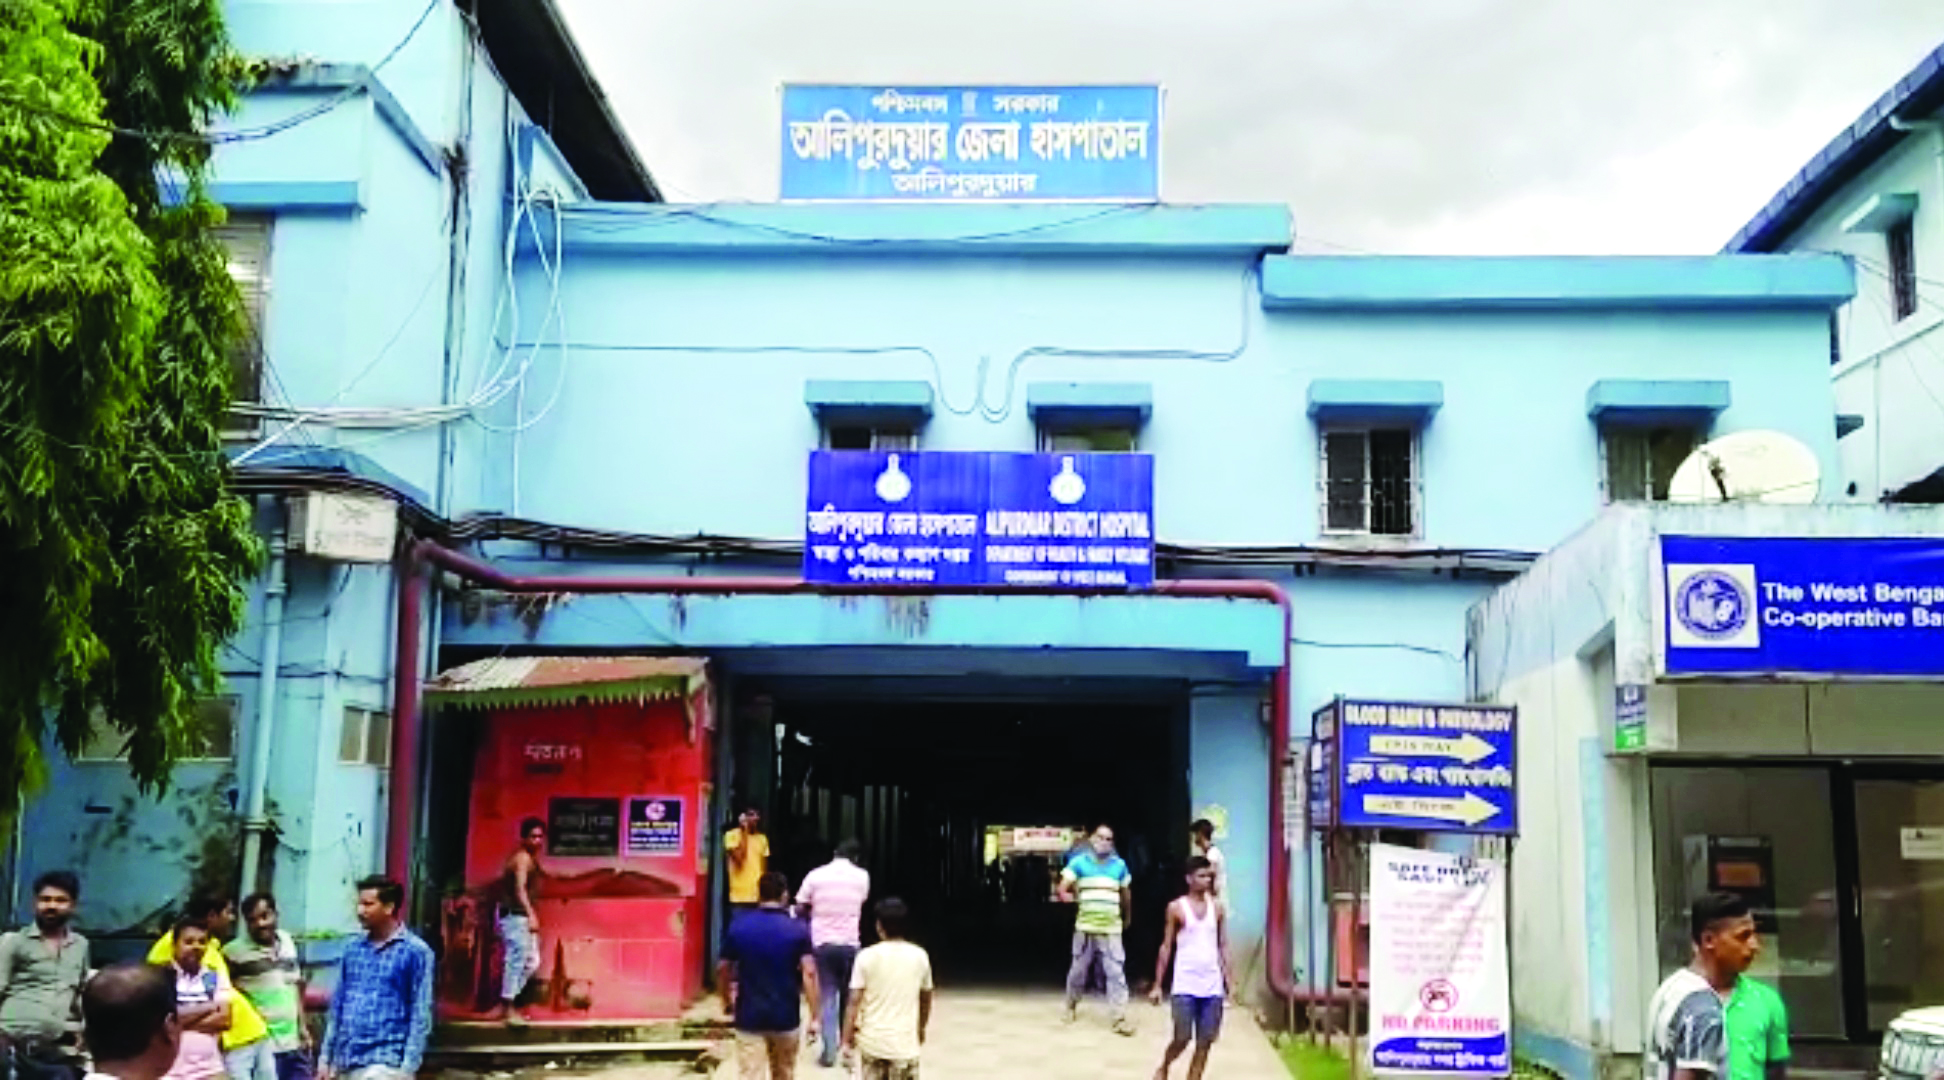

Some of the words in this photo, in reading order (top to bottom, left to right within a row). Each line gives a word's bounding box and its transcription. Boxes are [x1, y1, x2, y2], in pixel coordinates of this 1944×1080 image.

[993, 94, 1061, 114] সরকার
[789, 108, 949, 171] আলিপুরদুয়ার
[956, 121, 1020, 161] জেলা
[1030, 119, 1150, 161] হাসপাতাল
[892, 166, 1037, 196] আলিপুরদুয়ার
[1762, 582, 1803, 602] The
[1811, 582, 1868, 602] West
[1764, 607, 1906, 630] Co-operative
[1912, 607, 1944, 627] Ba
[1345, 704, 1387, 726] BLOOD
[1388, 706, 1424, 729] BANK
[1423, 742, 1452, 752] WAY
[1382, 1015, 1407, 1030] NO
[1413, 1015, 1499, 1031] PARKING
